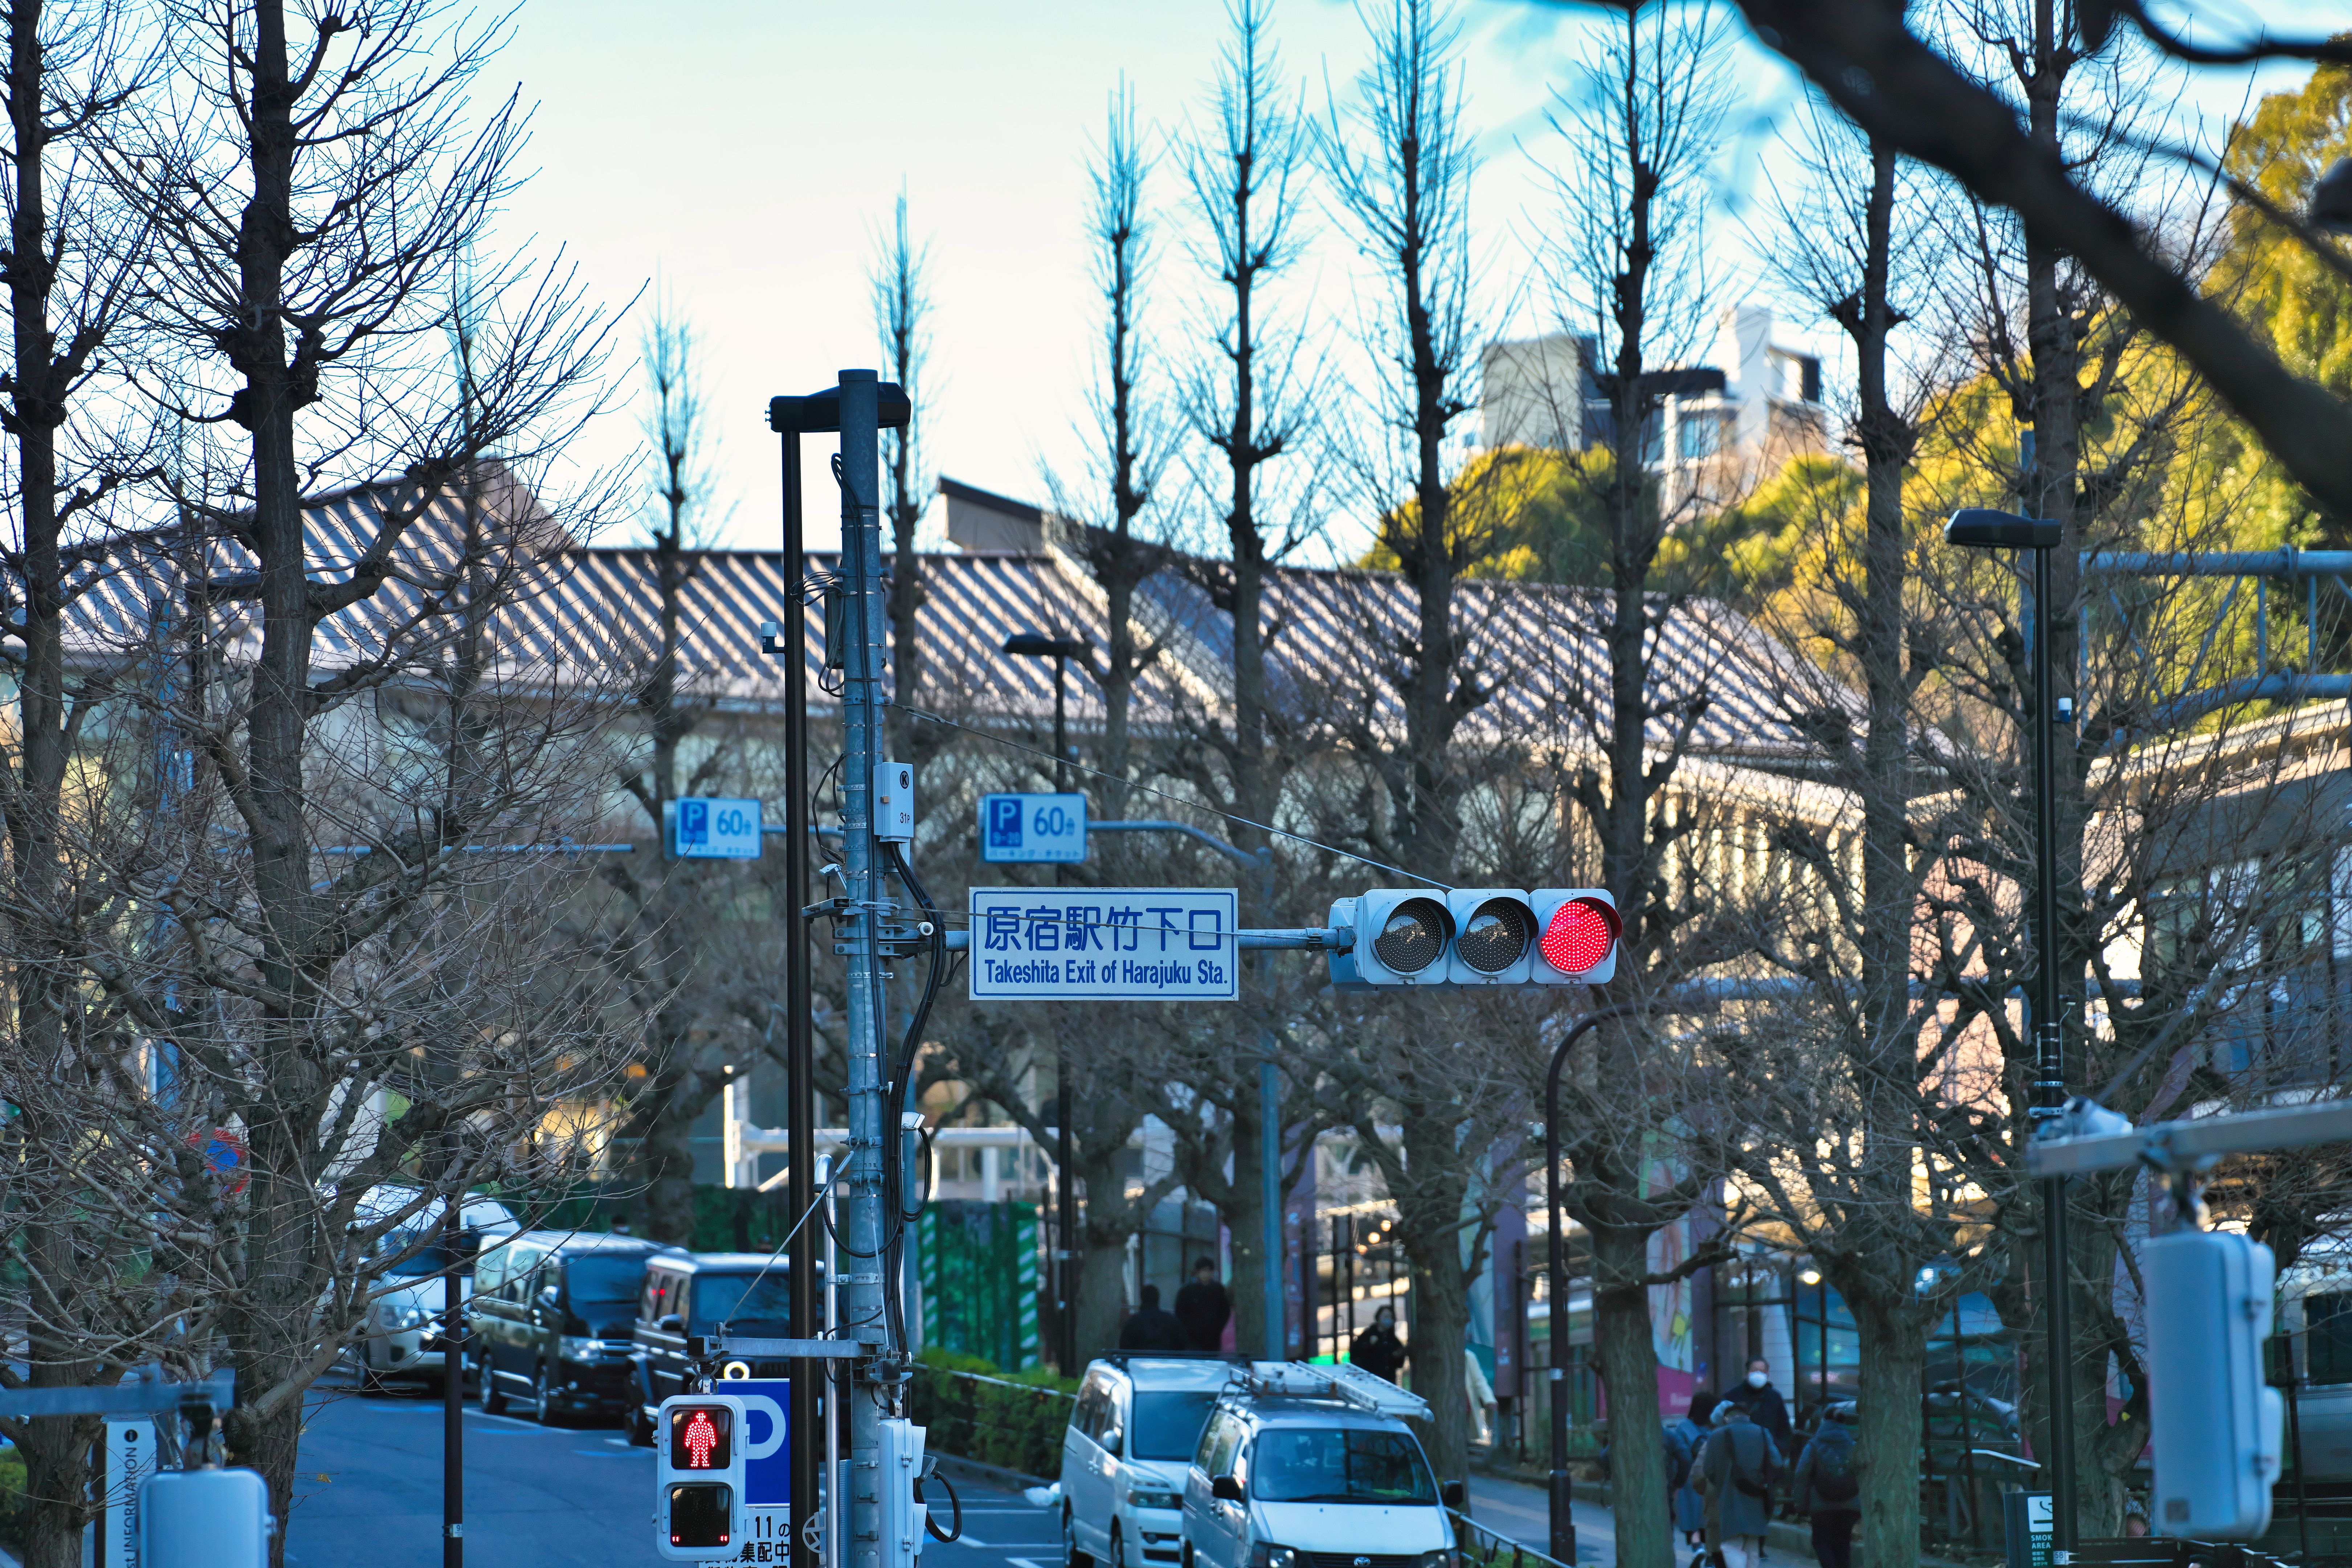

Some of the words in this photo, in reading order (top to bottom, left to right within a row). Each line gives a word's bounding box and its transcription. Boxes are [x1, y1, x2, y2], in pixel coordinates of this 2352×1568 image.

[902, 774, 907, 785] K
[687, 804, 703, 829] P
[998, 801, 1016, 830] P
[984, 905, 1222, 952] 原宿駅竹下口
[984, 959, 1059, 983] Takeshita
[1066, 960, 1096, 983] Exit
[1101, 960, 1117, 983] of
[1123, 960, 1191, 989] Harajuku
[1197, 959, 1228, 984] Sta.
